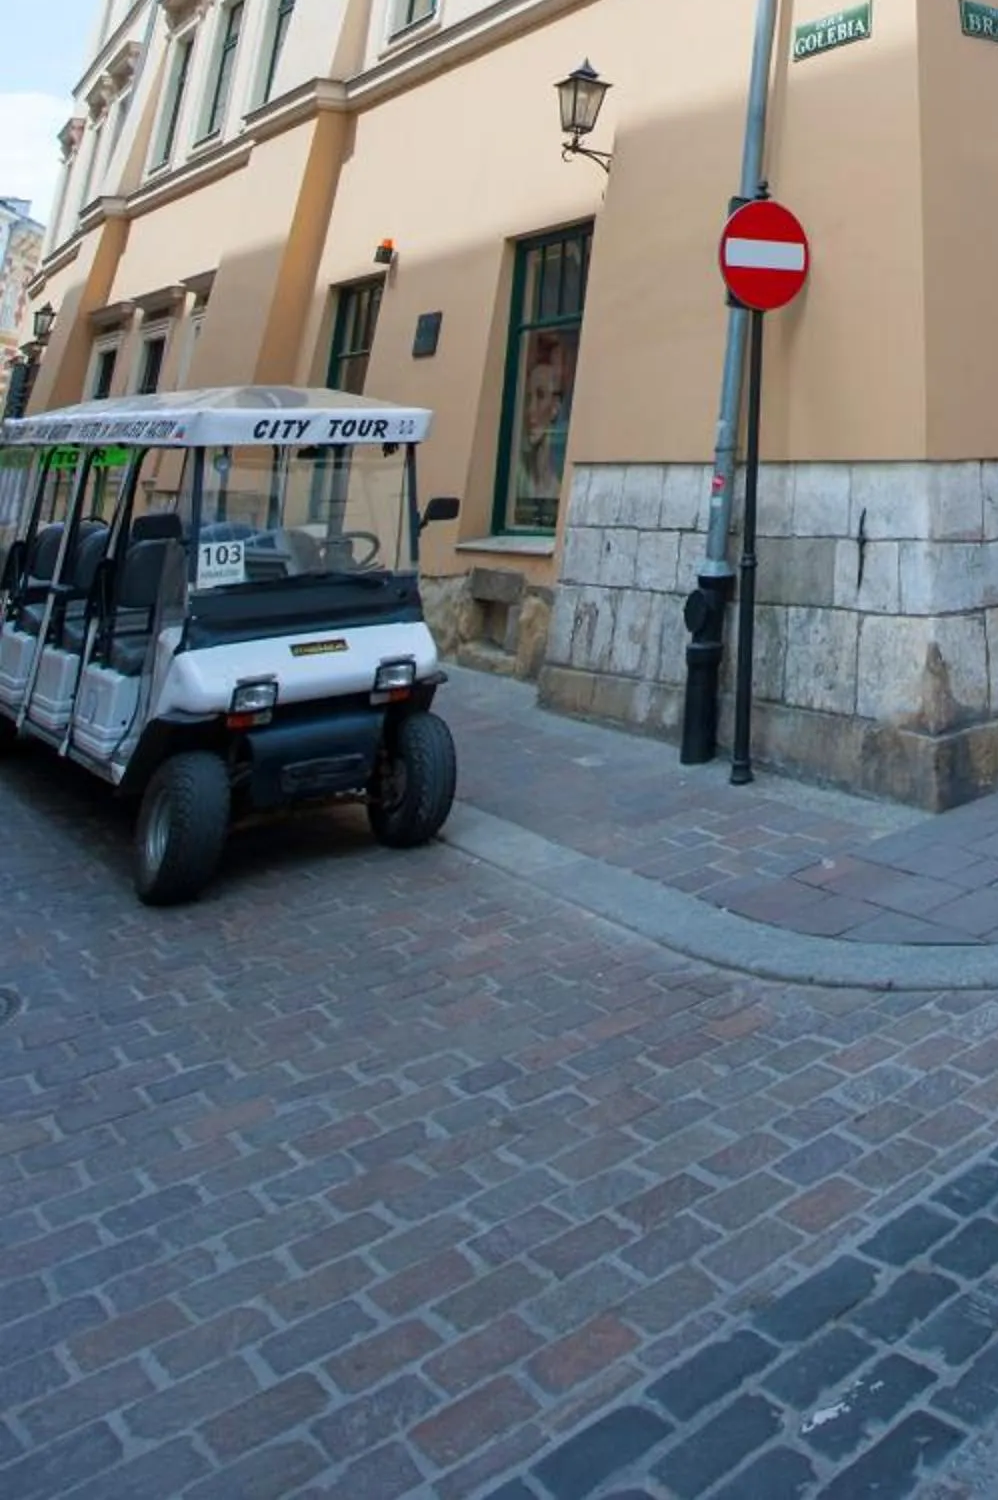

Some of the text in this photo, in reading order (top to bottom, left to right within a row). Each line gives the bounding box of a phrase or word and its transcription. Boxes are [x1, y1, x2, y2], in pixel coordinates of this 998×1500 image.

[253, 419, 390, 439] CITY TOUR
[203, 544, 242, 567] 103
